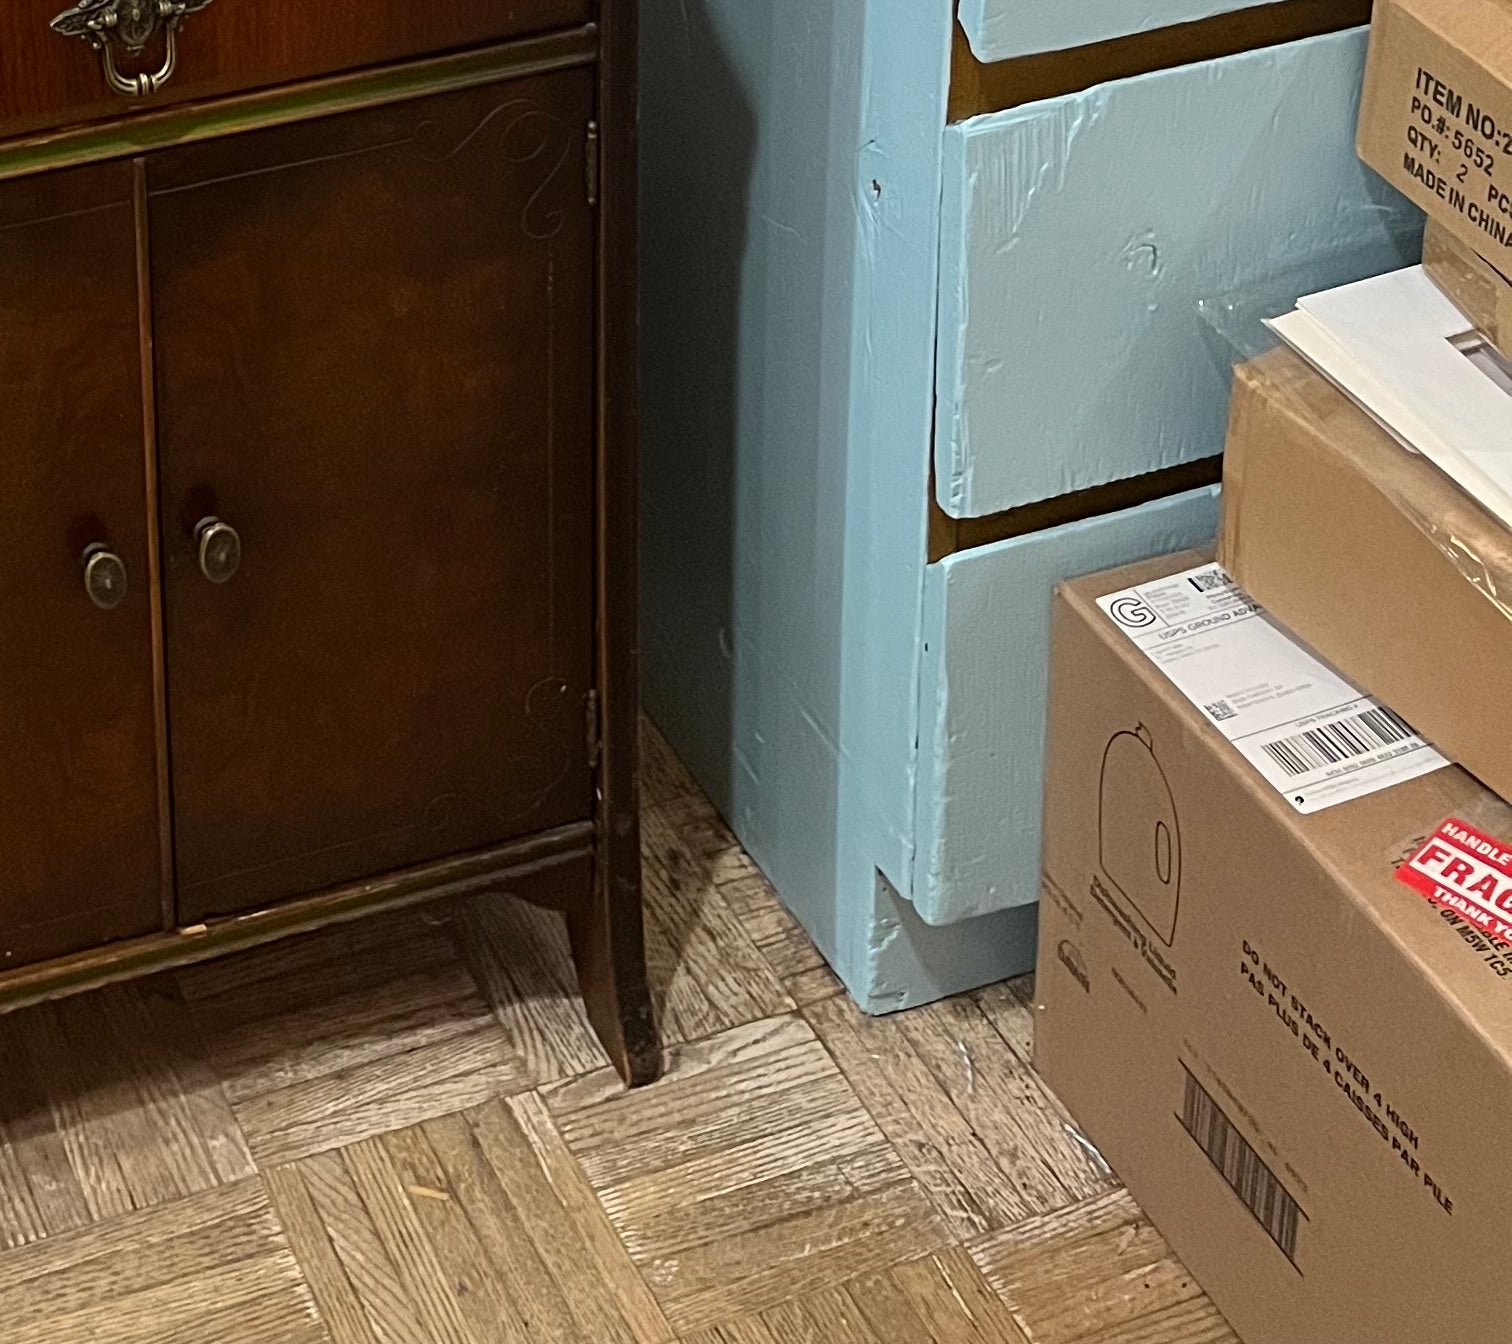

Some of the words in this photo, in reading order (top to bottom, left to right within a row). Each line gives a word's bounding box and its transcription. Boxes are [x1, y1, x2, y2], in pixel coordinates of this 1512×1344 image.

[1415, 66, 1463, 119] ITEM
[1407, 124, 1441, 164] QTY:
[1456, 163, 1469, 184] 2
[1451, 128, 1495, 178] 5652
[1403, 151, 1448, 200] MADE
[1448, 186, 1466, 214] IN
[1109, 596, 1157, 628] G
[1157, 625, 1188, 641] USPS
[1188, 611, 1232, 632] GROUND
[1441, 822, 1512, 867] HANDLE
[1433, 885, 1494, 927] THANK
[1439, 909, 1460, 927] ON
[1456, 924, 1491, 953] M5W
[1242, 939, 1260, 966] DO
[1263, 962, 1288, 998] NOT
[1291, 994, 1332, 1051] STACK
[1335, 1046, 1371, 1095] OVER
[1373, 1092, 1383, 1109] 4
[1386, 1103, 1420, 1151] HIGH
[1240, 960, 1265, 998] PAS
[1268, 992, 1300, 1038] PLUS
[1302, 1032, 1321, 1063] DE
[1322, 1058, 1332, 1074] 4
[1334, 1069, 1389, 1142] CAISSES
[1392, 1135, 1421, 1179] PAR
[1423, 1171, 1455, 1217] PILE
